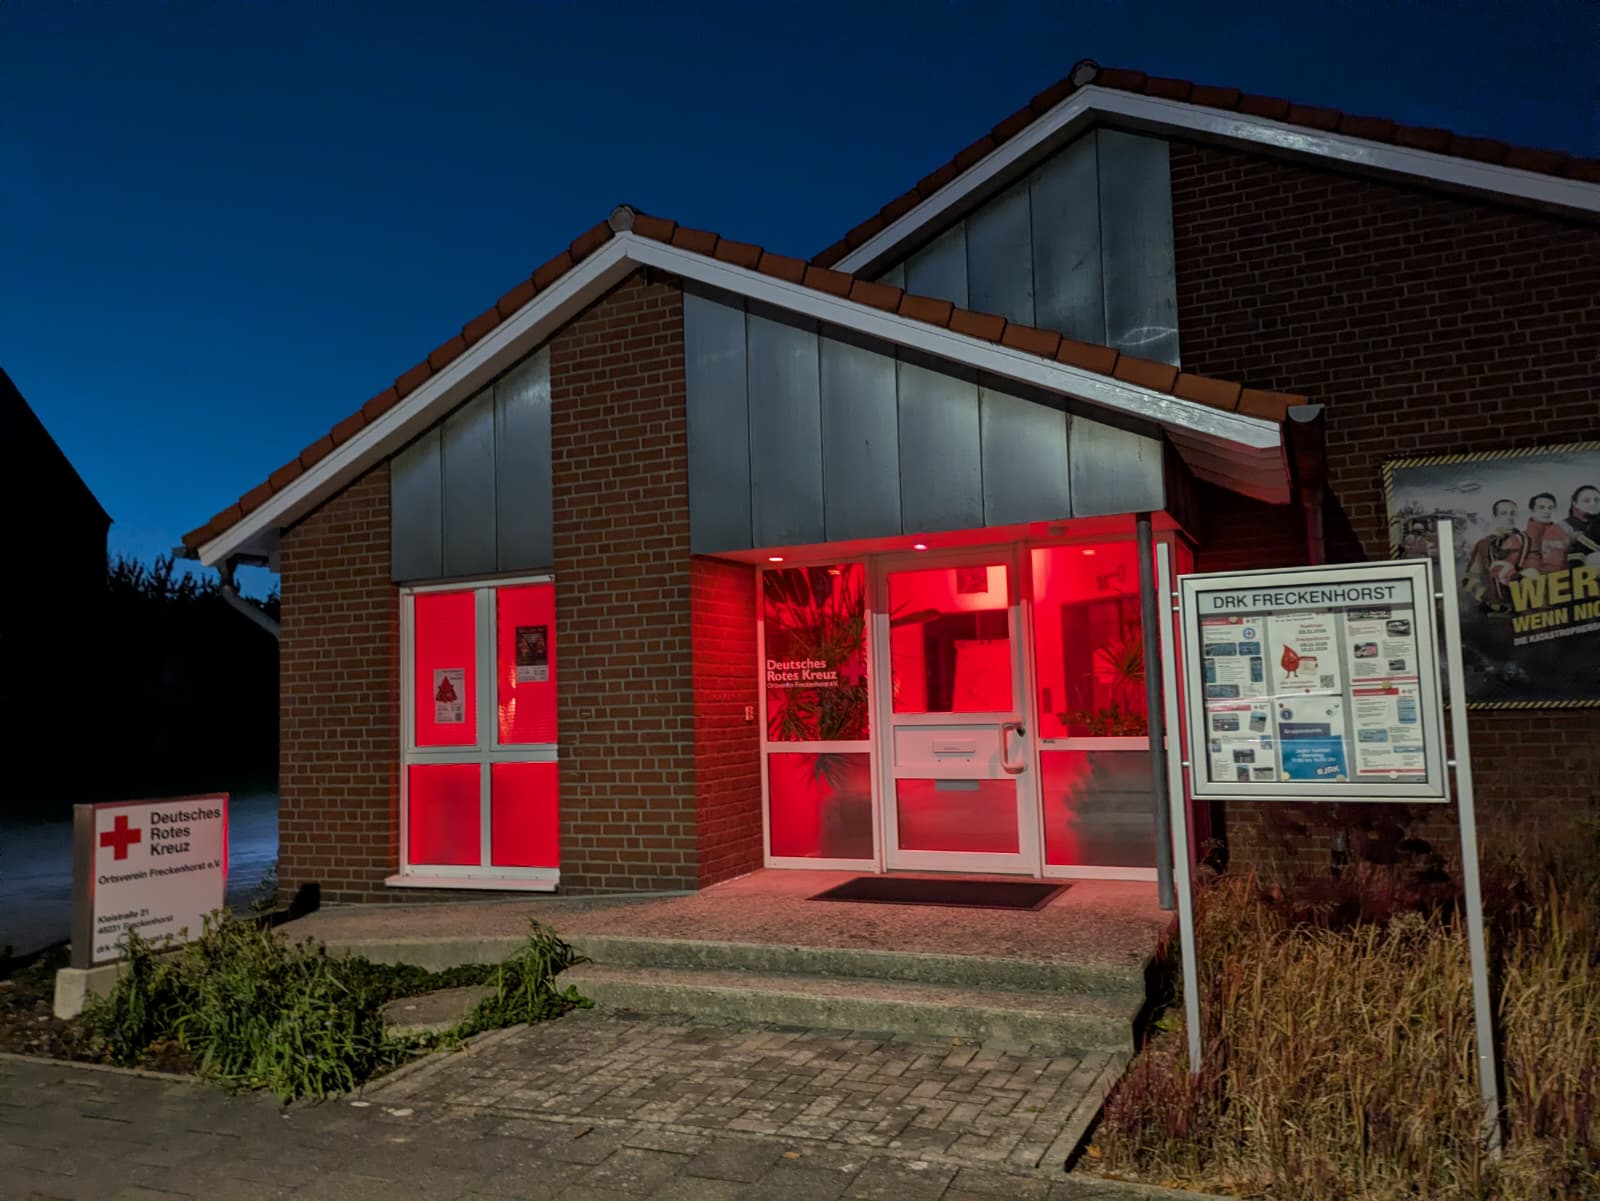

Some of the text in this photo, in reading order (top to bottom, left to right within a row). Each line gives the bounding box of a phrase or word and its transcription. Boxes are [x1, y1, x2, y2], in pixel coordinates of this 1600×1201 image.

[1509, 565, 1600, 612] WER
[1213, 586, 1396, 609] DRK FRECKENHORST
[1512, 607, 1569, 633] WENN
[767, 658, 827, 670] Deutsches
[767, 669, 838, 682] Rotes Kreuz
[151, 808, 221, 825] Deutsches
[151, 826, 191, 841] Rotes
[151, 841, 191, 856] Kreuz
[98, 871, 148, 885] Ortsverein
[149, 862, 206, 878] Freckenhorst
